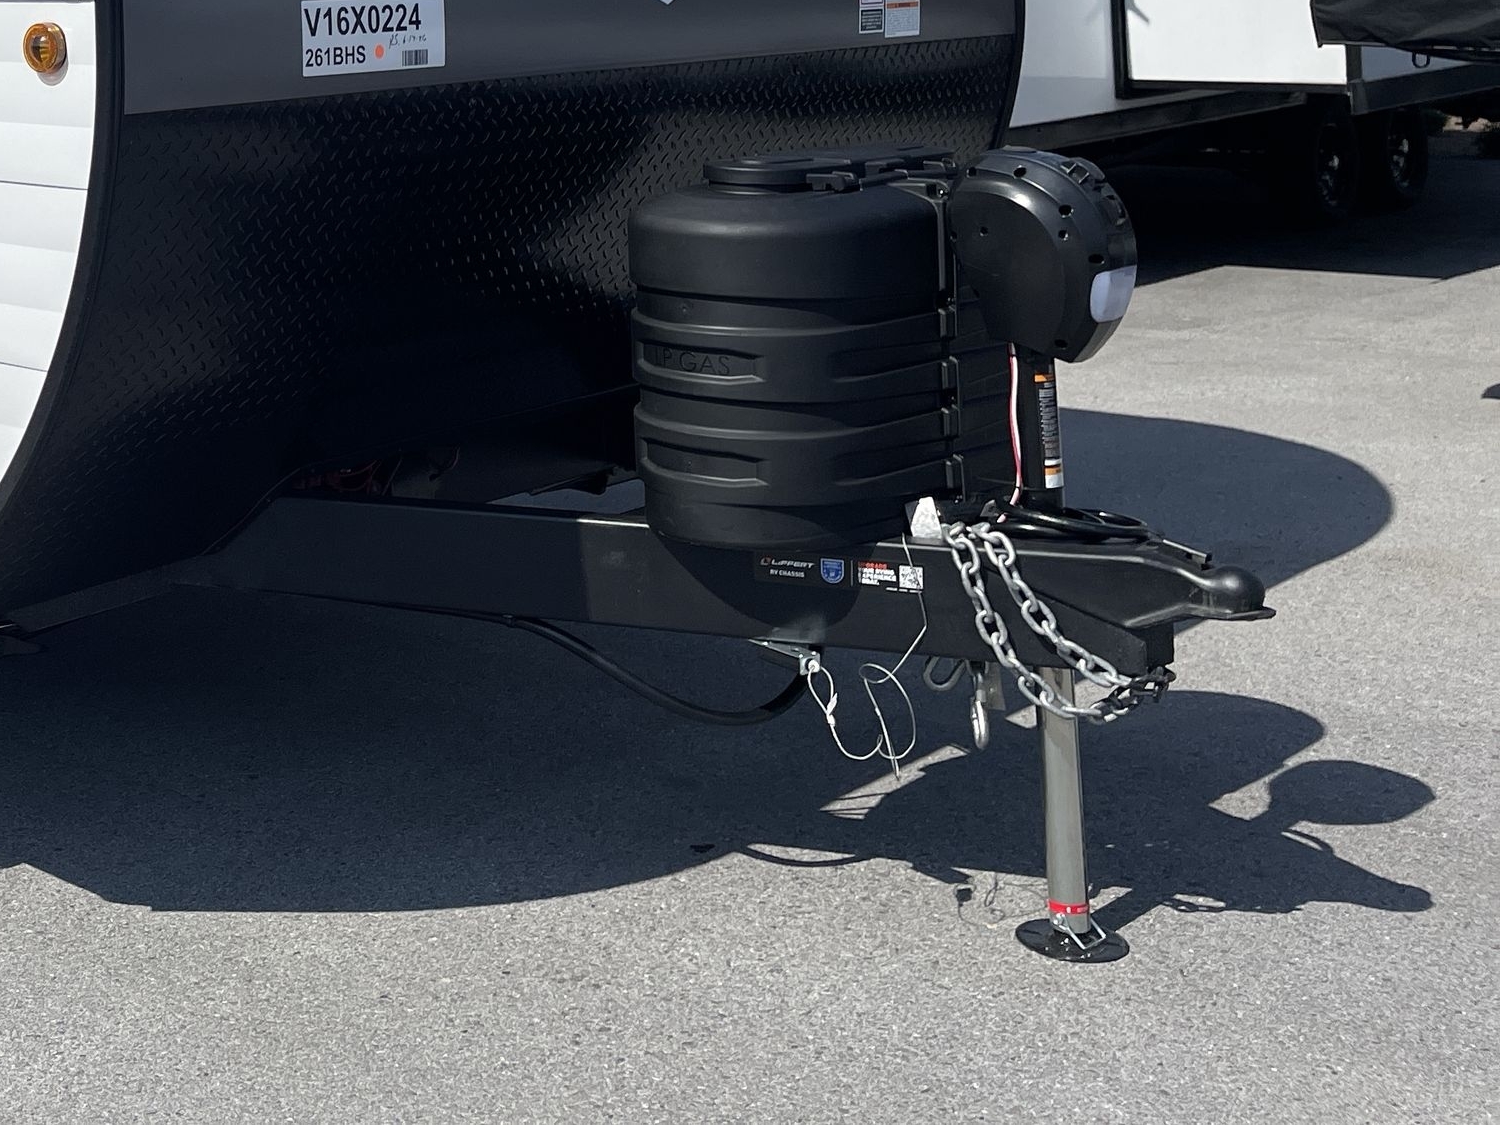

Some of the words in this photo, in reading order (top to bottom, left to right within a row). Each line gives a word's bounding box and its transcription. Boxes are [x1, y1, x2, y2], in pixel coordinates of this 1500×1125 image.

[304, 3, 422, 37] V16X0224
[305, 45, 366, 67] 261BHS
[680, 351, 730, 375] GAS
